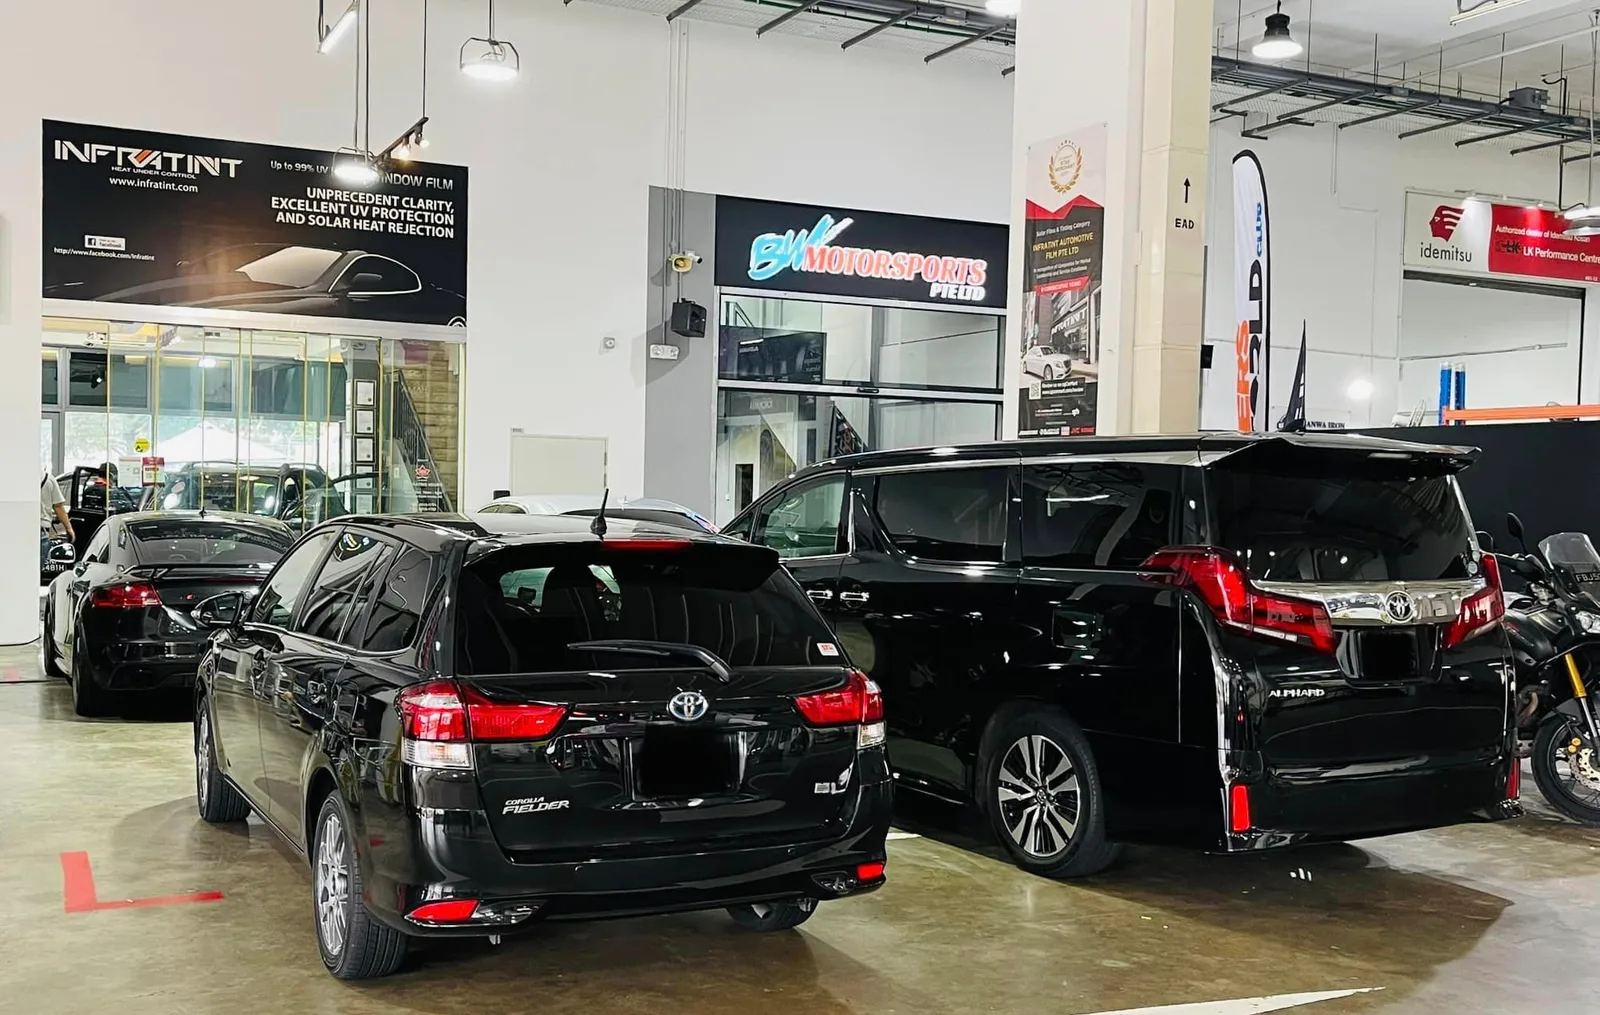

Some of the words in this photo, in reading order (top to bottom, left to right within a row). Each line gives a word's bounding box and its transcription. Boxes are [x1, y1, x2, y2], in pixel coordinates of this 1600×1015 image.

[54, 139, 243, 178] INFRATINT
[133, 168, 160, 176] UNDER
[161, 171, 197, 180] CONTROL
[270, 160, 282, 170] Up
[284, 161, 293, 170] to
[295, 162, 314, 173] 99%
[316, 165, 329, 174] UV
[109, 177, 199, 193] www.infratint.com
[381, 171, 423, 187] INDOW
[425, 177, 454, 190] FILM
[306, 186, 400, 207] UNPRECEDENT
[401, 196, 454, 214] CLARITY,
[271, 196, 348, 215] EXCELLENT
[349, 203, 369, 217] UV
[371, 206, 454, 226] PROTECTION
[276, 211, 306, 225] AND
[307, 214, 351, 229] SOLAR
[353, 218, 386, 232] HEAT
[388, 221, 454, 239] REJECTION
[1175, 217, 1195, 230] EAD
[1420, 241, 1472, 263] idemitsu
[1523, 246, 1534, 257] LK
[1535, 247, 1578, 261] Performance
[802, 245, 987, 286] MOTORSPORTS
[1268, 688, 1326, 698] ALPHARD
[502, 800, 570, 815] FIELDER
[505, 796, 545, 806] COROLLA
